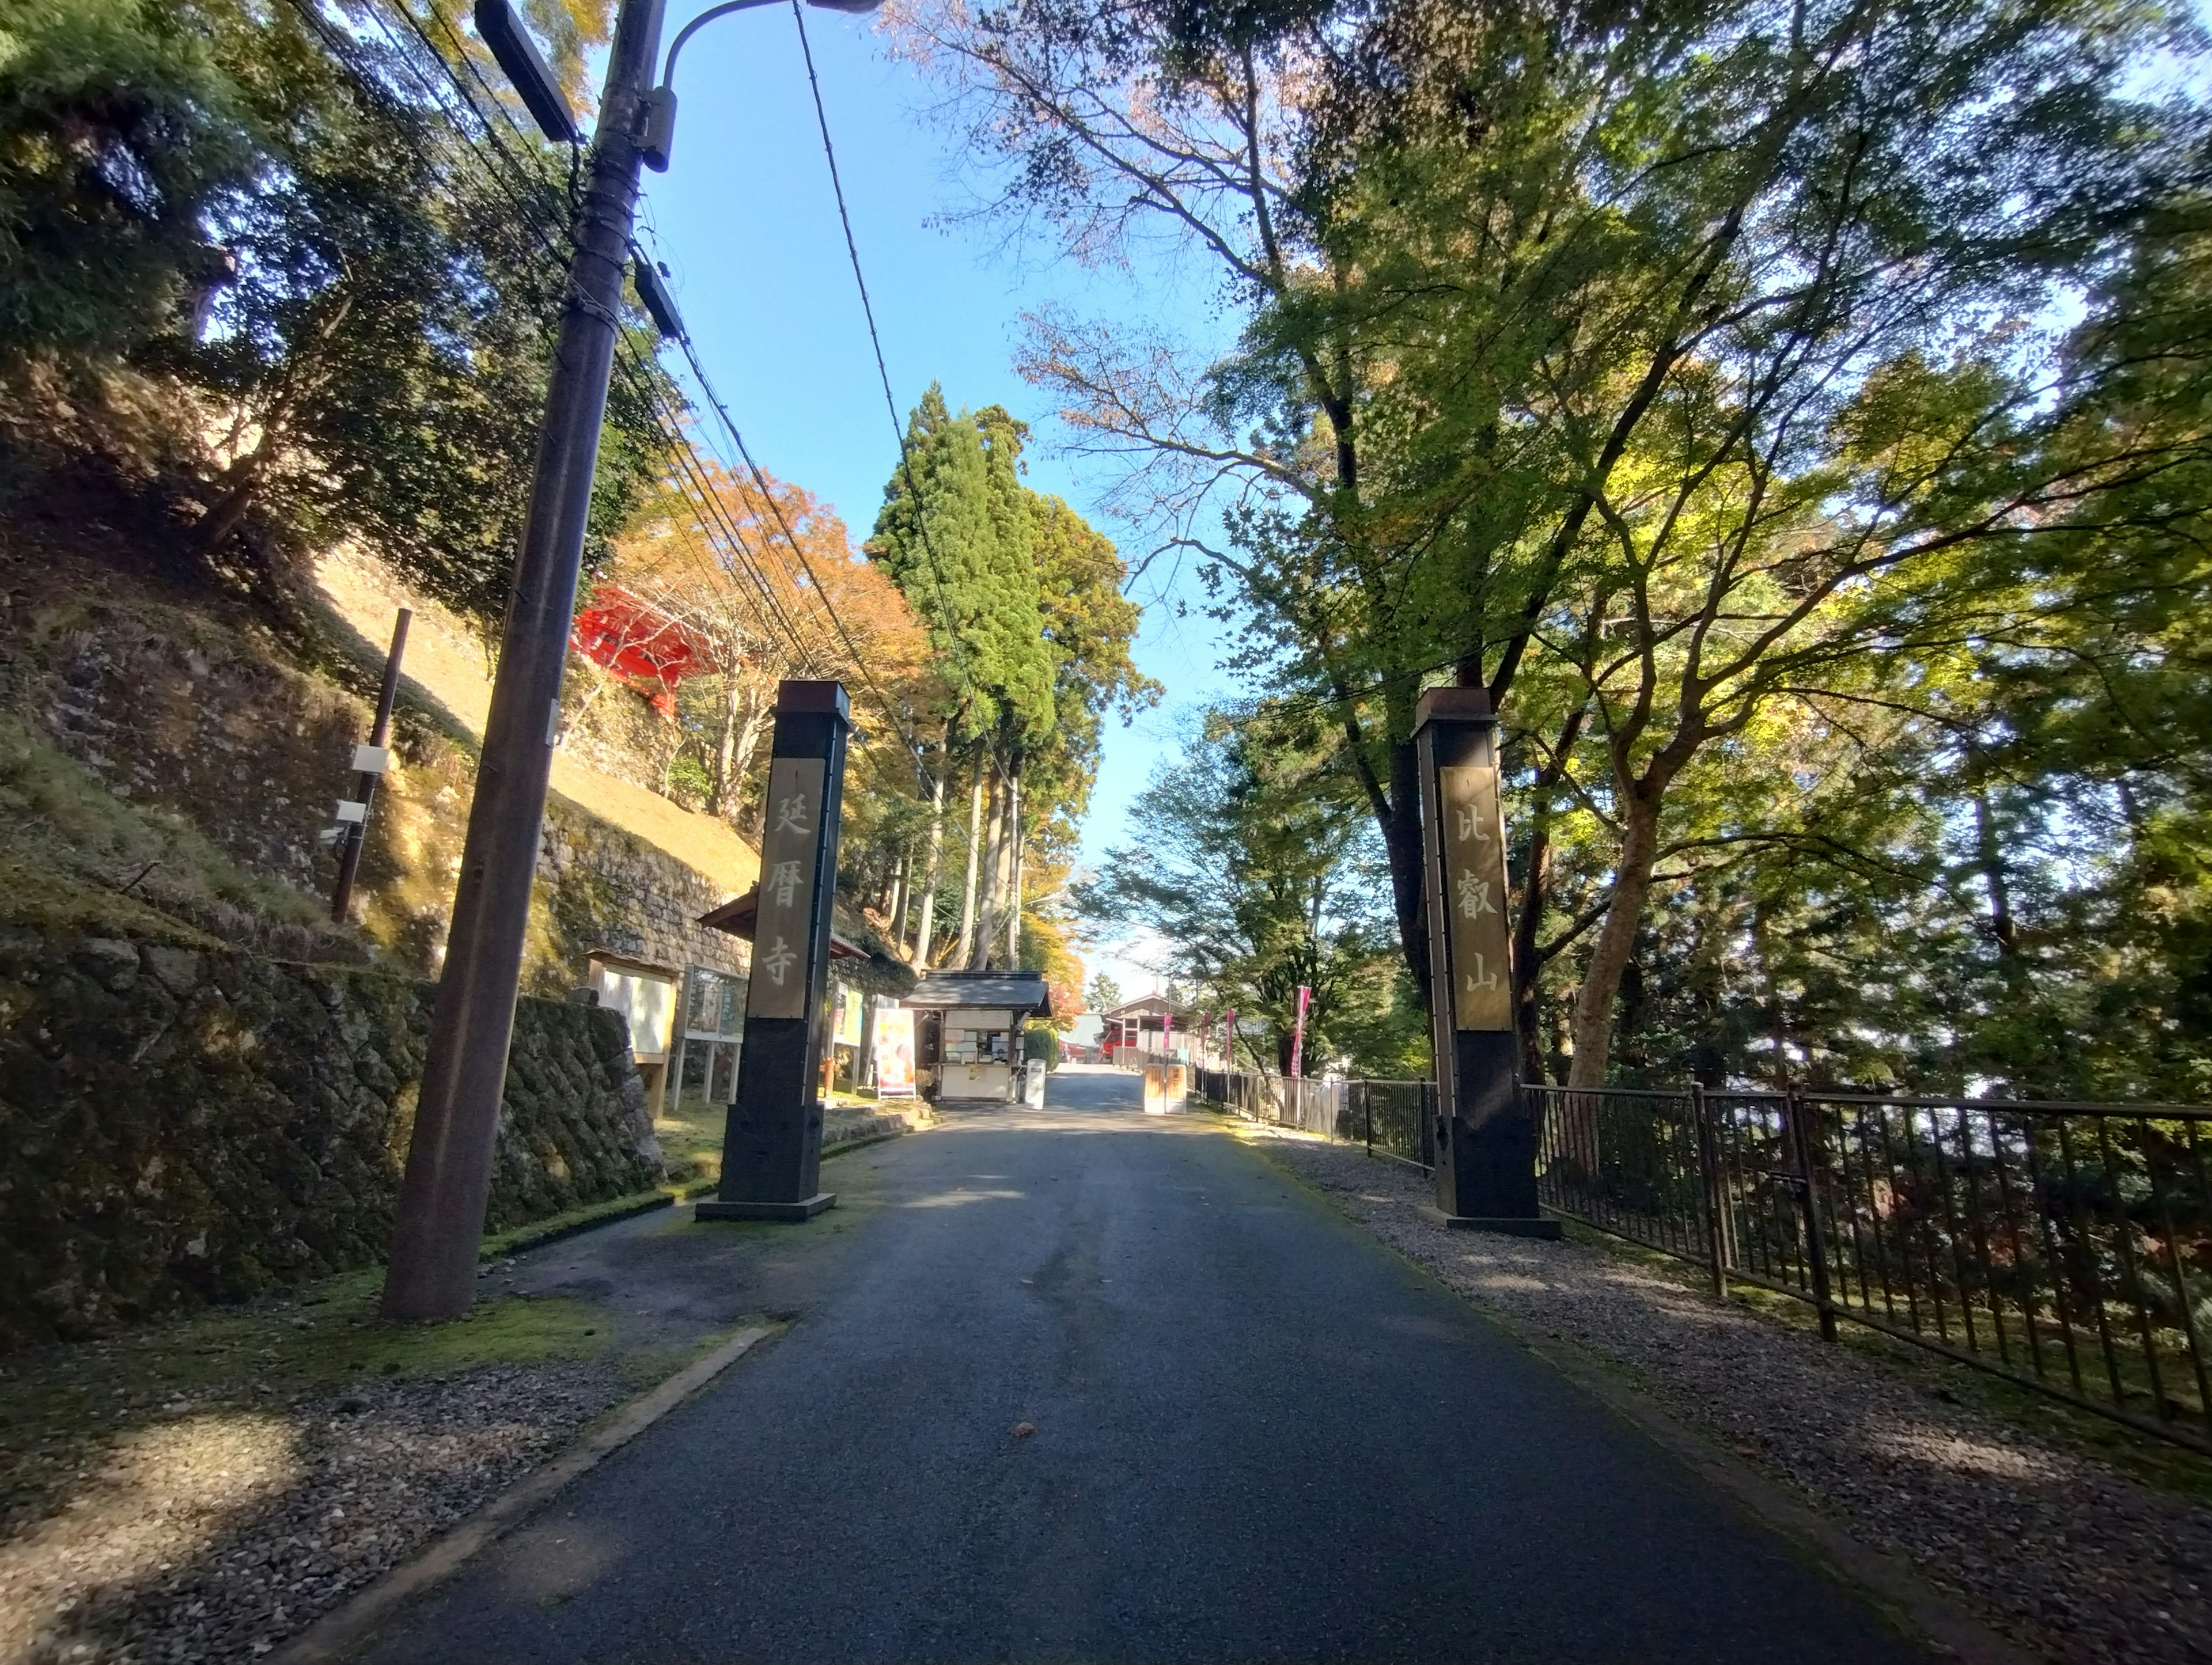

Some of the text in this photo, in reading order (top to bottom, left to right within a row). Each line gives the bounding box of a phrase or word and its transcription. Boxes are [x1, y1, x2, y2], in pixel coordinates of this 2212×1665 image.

[761, 793, 811, 986] 延暦寺
[1456, 805, 1498, 992] 比叡山
